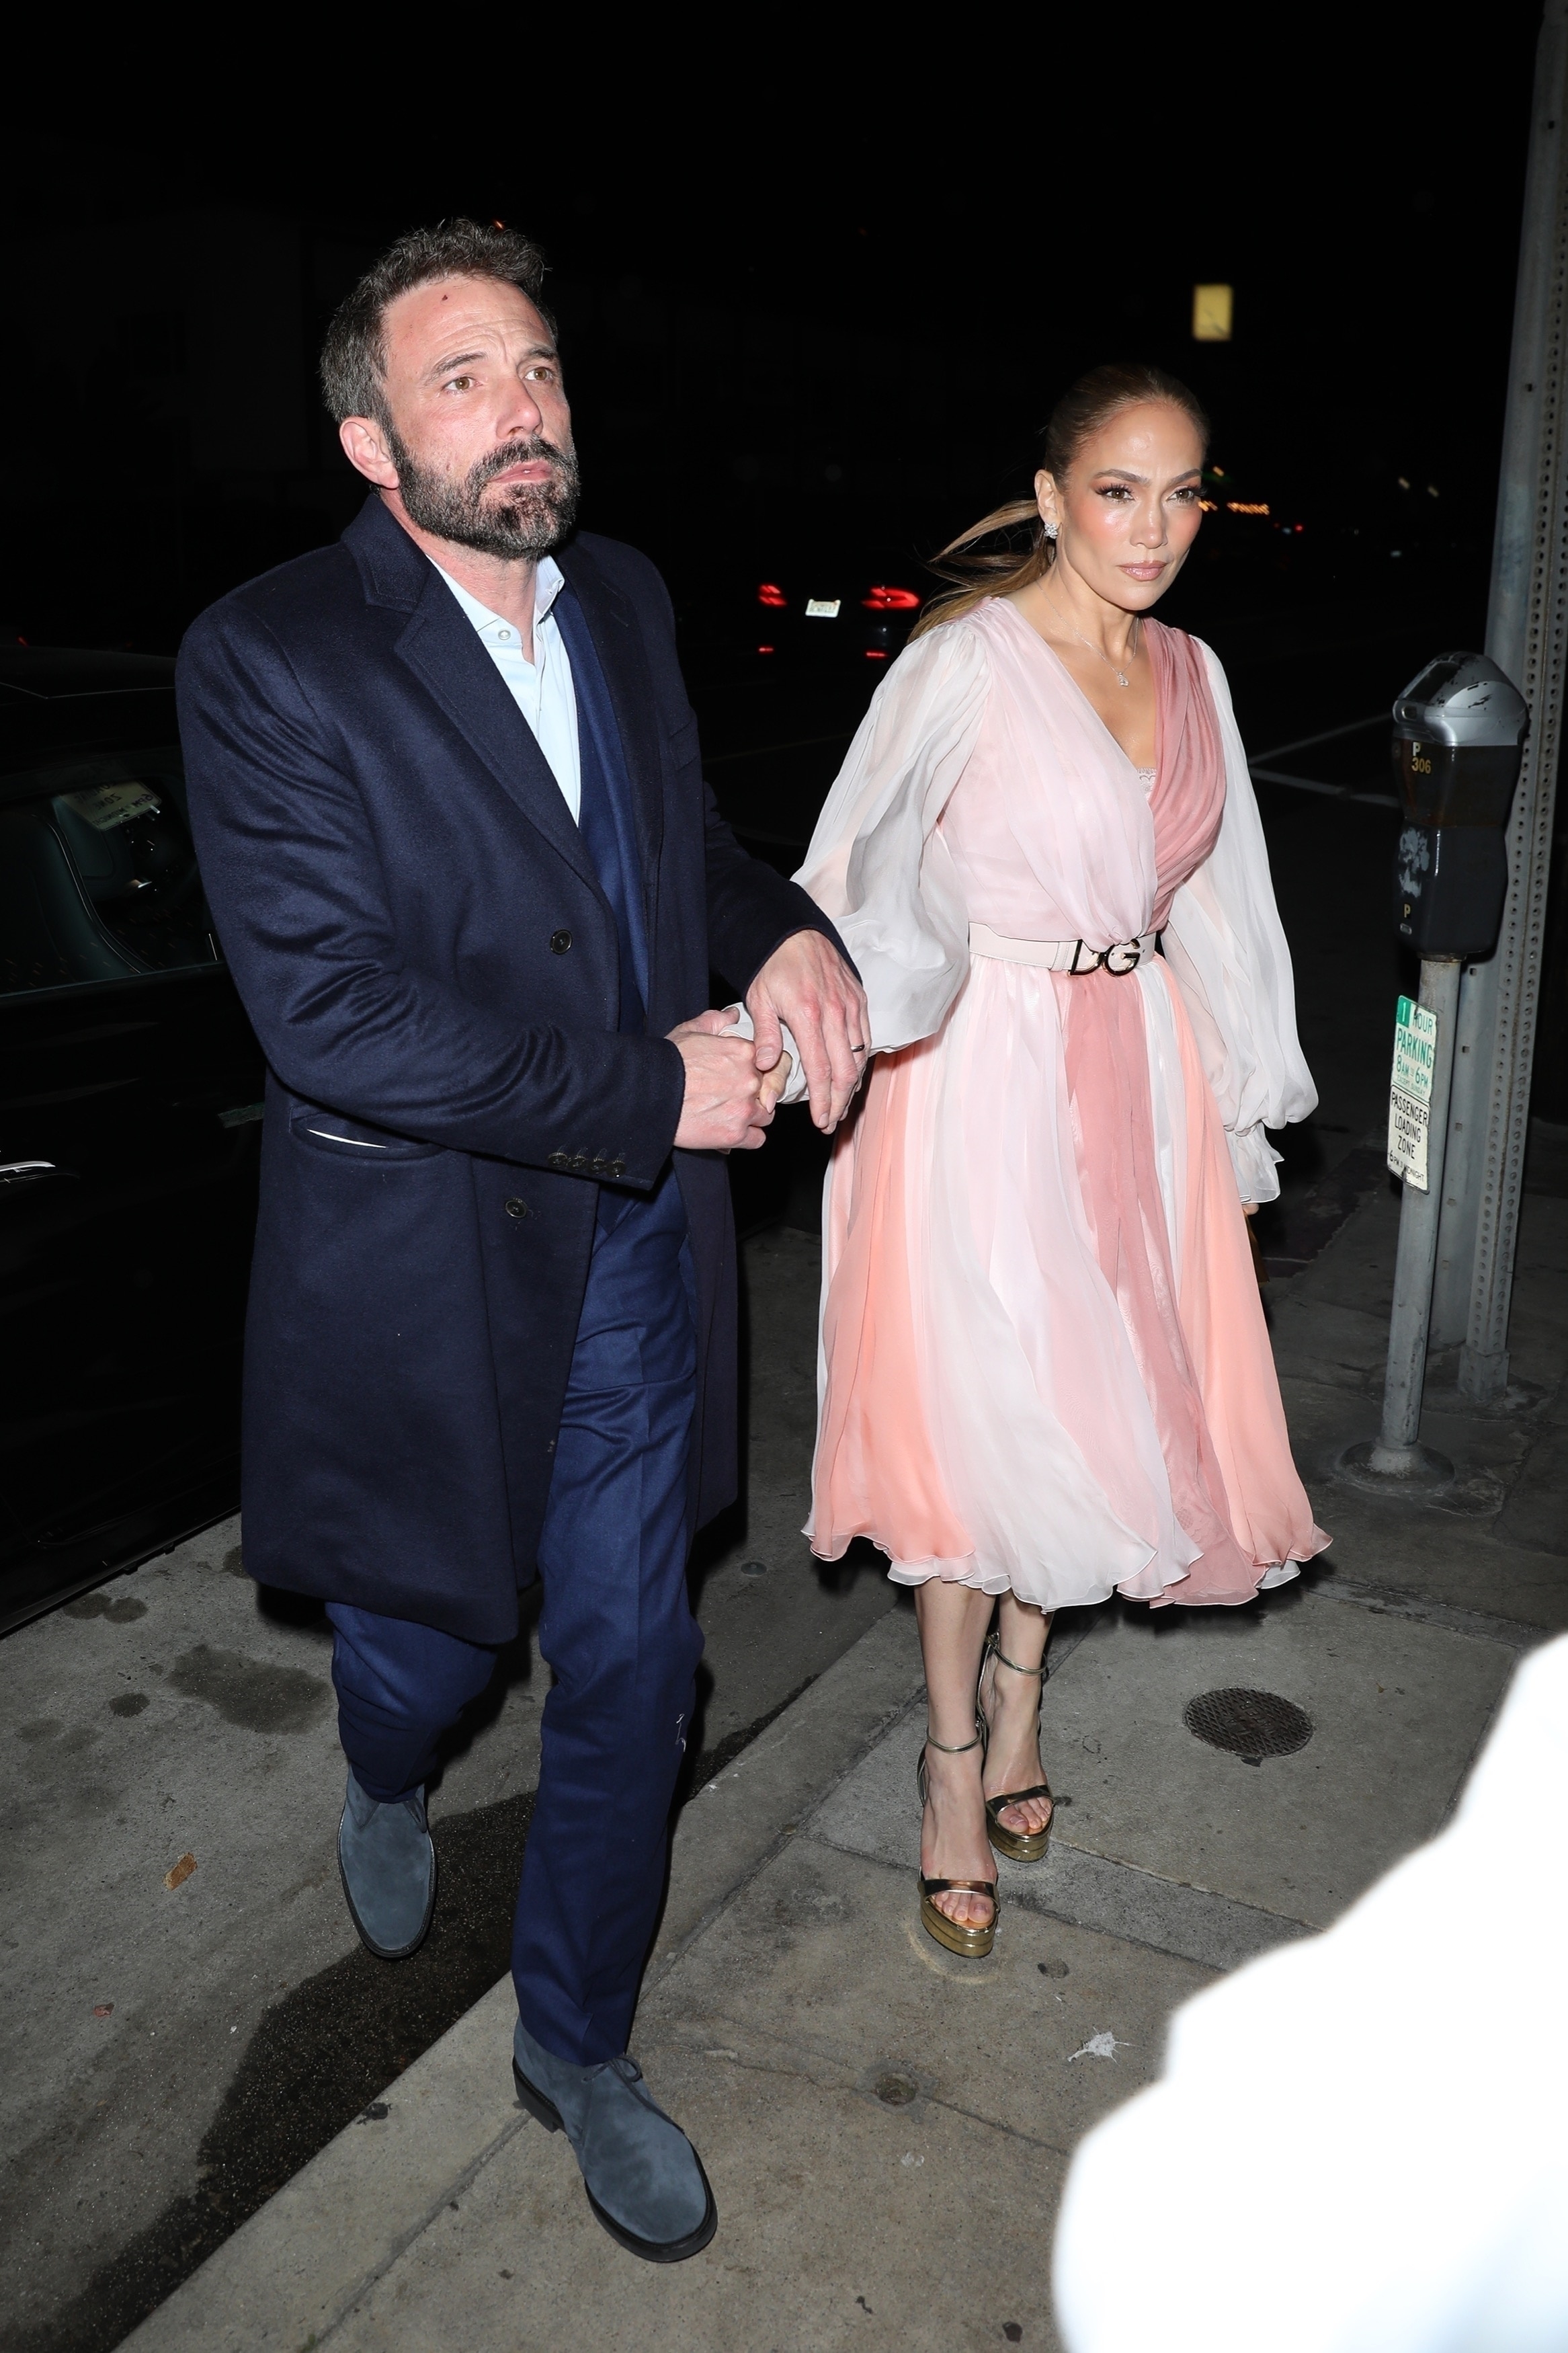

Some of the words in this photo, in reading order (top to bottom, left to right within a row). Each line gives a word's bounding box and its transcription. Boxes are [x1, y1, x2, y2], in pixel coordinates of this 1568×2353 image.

[1413, 742, 1421, 756] P
[1411, 757, 1431, 774] 306
[1404, 904, 1411, 918] P
[1401, 1002, 1407, 1022] 1
[1413, 1012, 1433, 1035] HOUR
[1397, 1027, 1432, 1069] PARKING
[1391, 1091, 1428, 1127] PASSENGER
[1395, 1113, 1421, 1143] LOADING
[1397, 1135, 1415, 1160] ZONE
